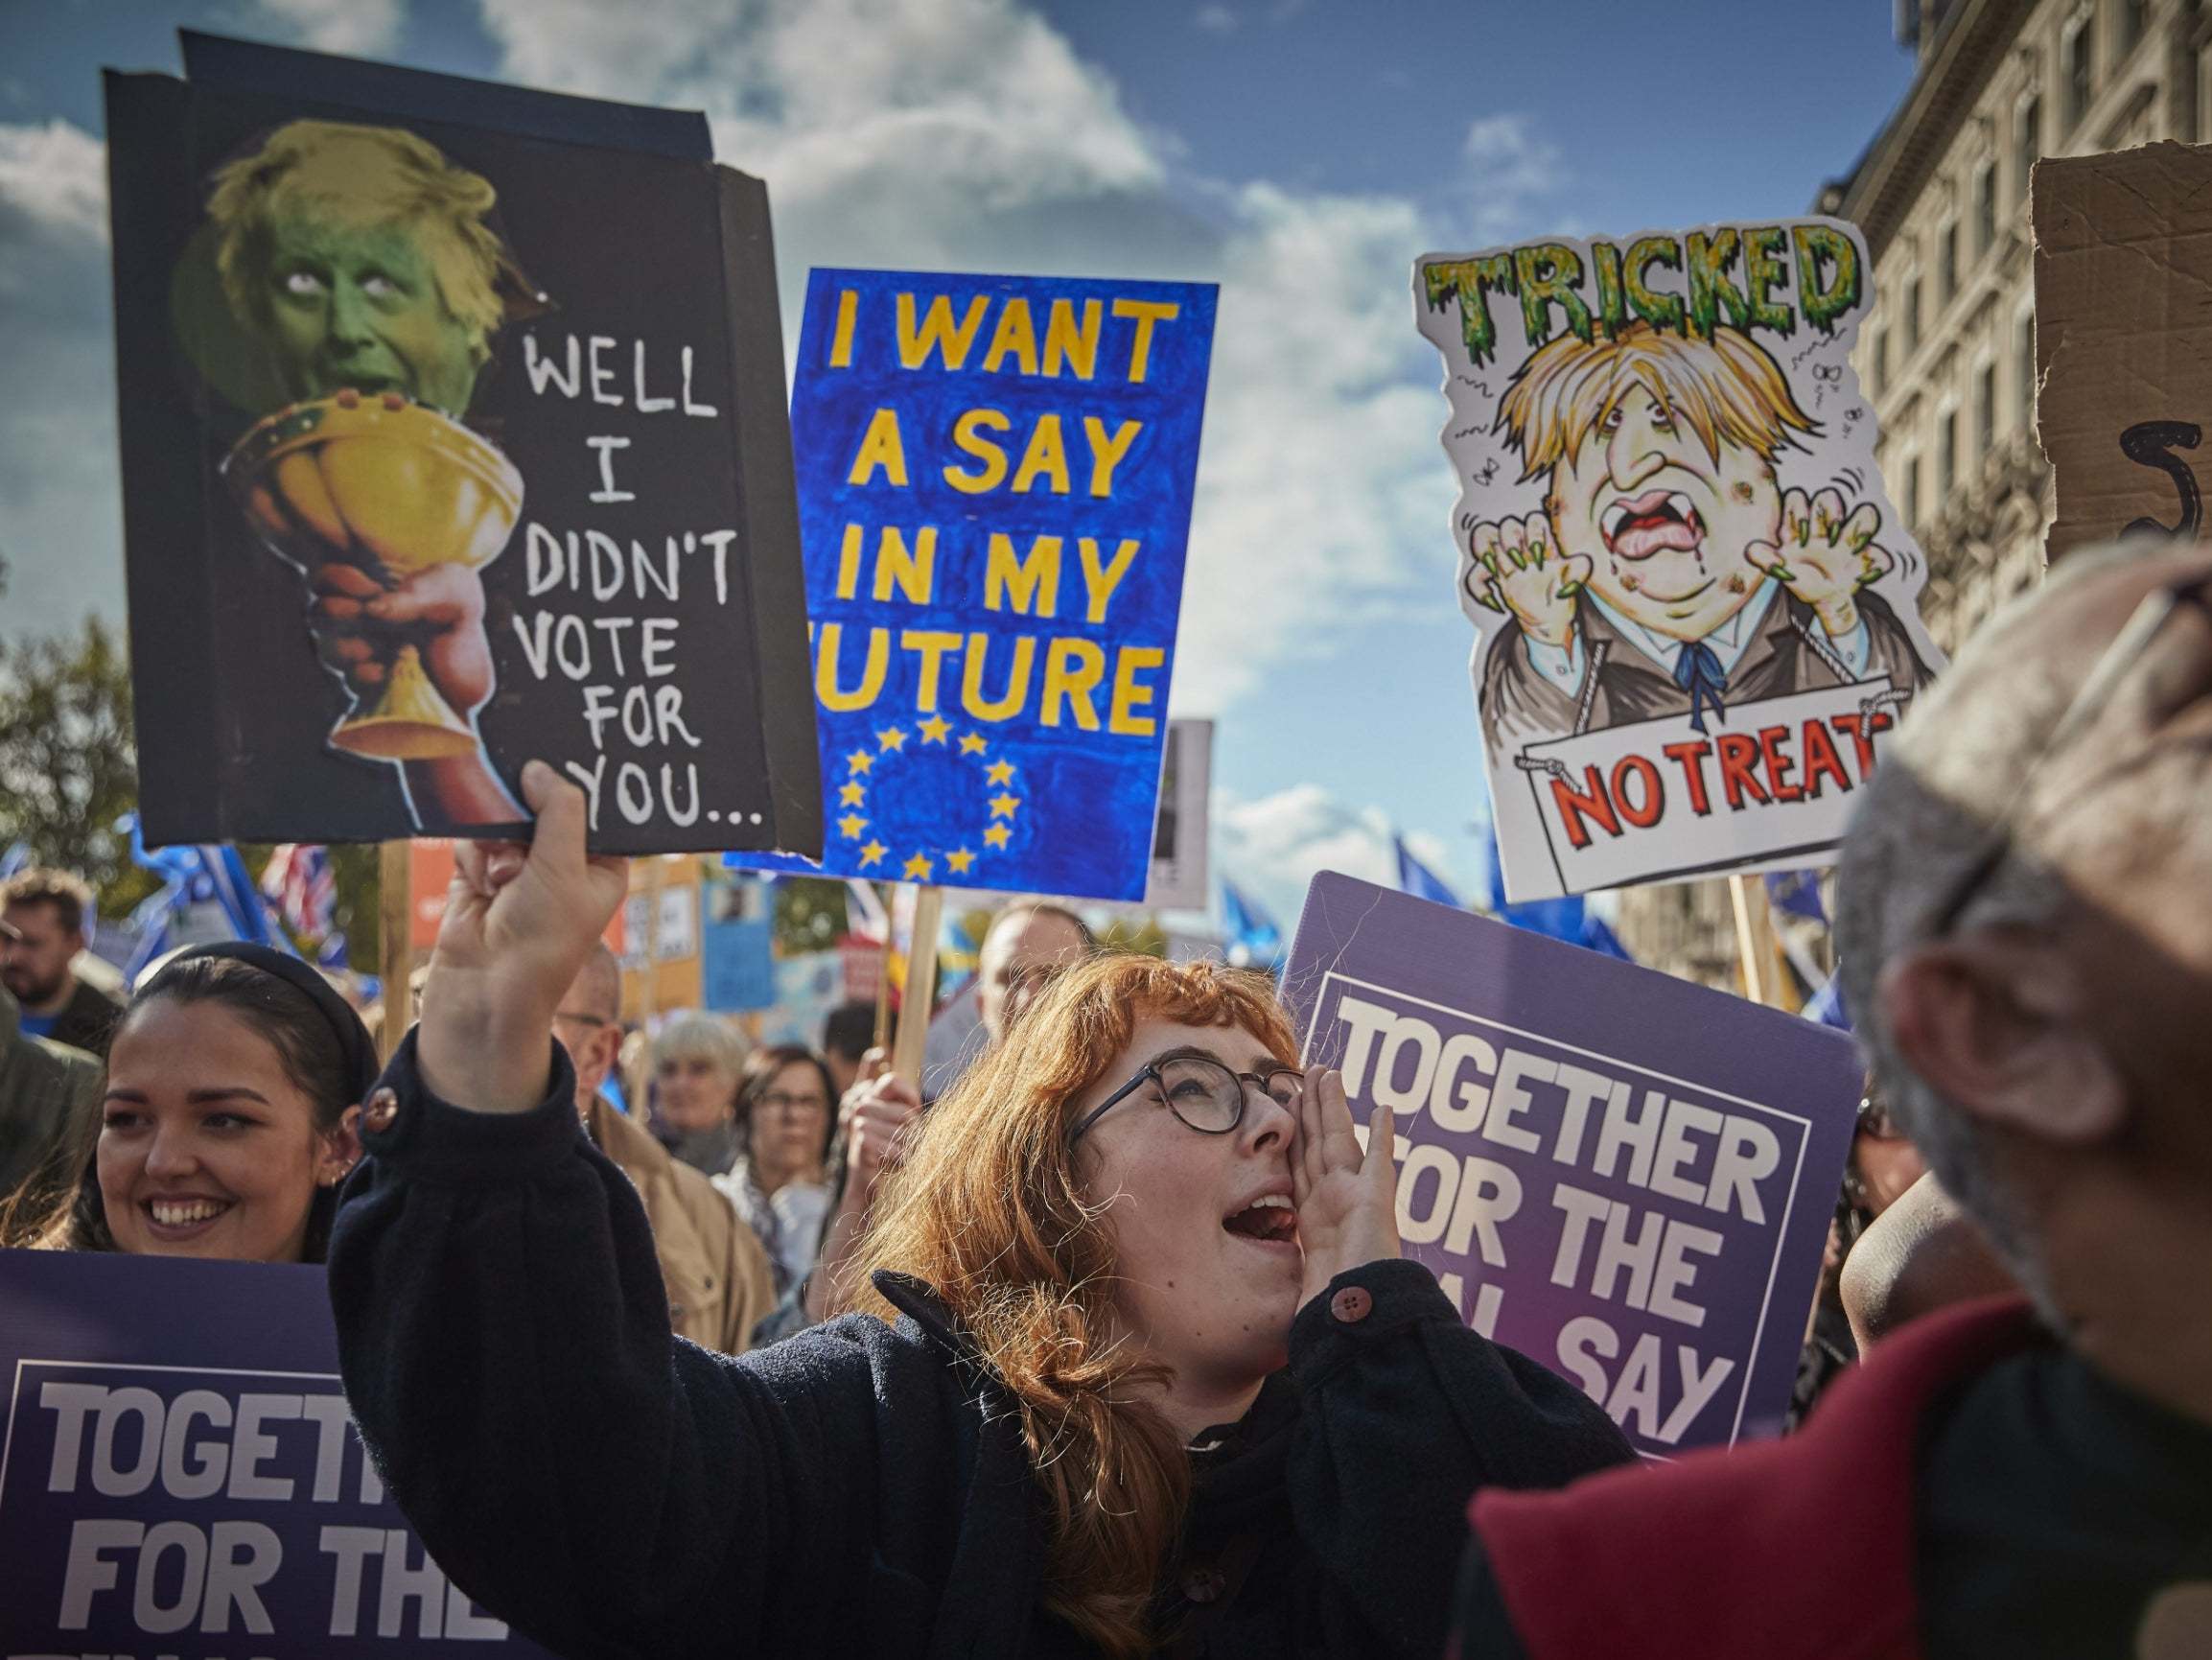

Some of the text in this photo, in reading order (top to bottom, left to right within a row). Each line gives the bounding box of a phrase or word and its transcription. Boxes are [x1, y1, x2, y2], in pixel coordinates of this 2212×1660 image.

[829, 290, 1180, 383] I WANT
[1425, 224, 1862, 367] TRICKED
[523, 334, 717, 417] WELL
[586, 436, 636, 502] I
[849, 408, 1143, 499] A SAY
[526, 521, 737, 605] DIDN'T
[836, 524, 1141, 624] IN MY
[514, 609, 679, 680] VOTE
[808, 620, 1165, 736] UTURE
[583, 683, 702, 749] FOR
[1549, 712, 1894, 849] NO TREAT
[1337, 996, 1781, 1226] TOGETHER
[1550, 1183, 1724, 1327] THE
[1557, 1316, 1735, 1445] SAY
[58, 1520, 283, 1634] FOR
